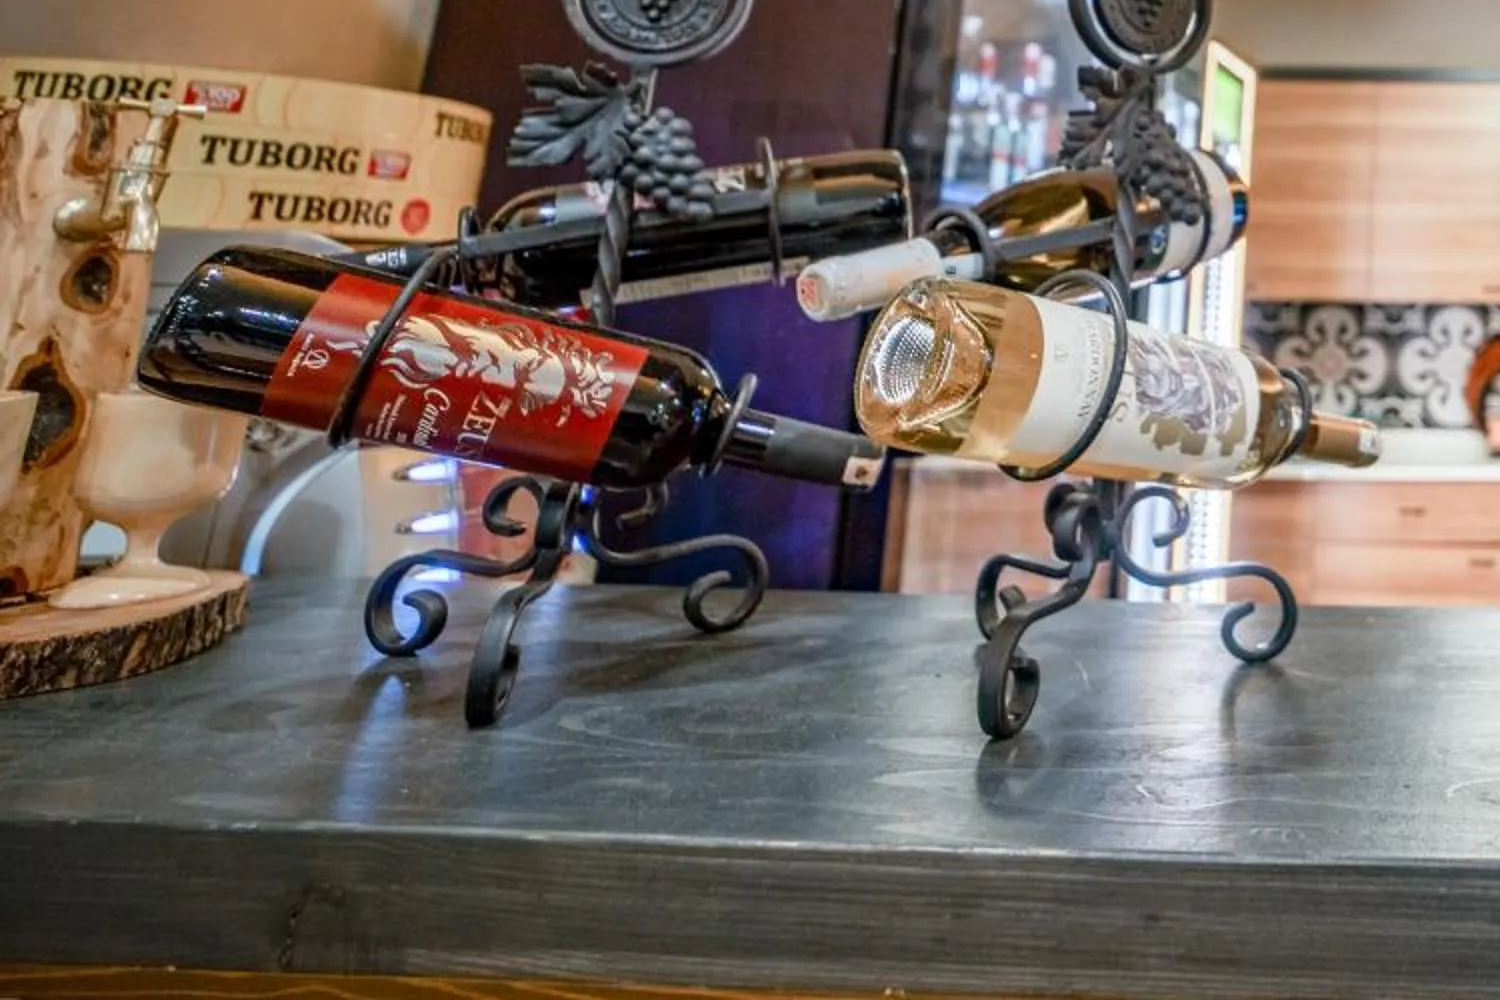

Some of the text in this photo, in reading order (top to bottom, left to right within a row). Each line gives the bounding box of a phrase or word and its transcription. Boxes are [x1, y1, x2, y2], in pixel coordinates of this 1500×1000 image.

[14, 70, 172, 101] TUBORG
[200, 134, 360, 175] TUBORG
[248, 190, 393, 229] TUBORG
